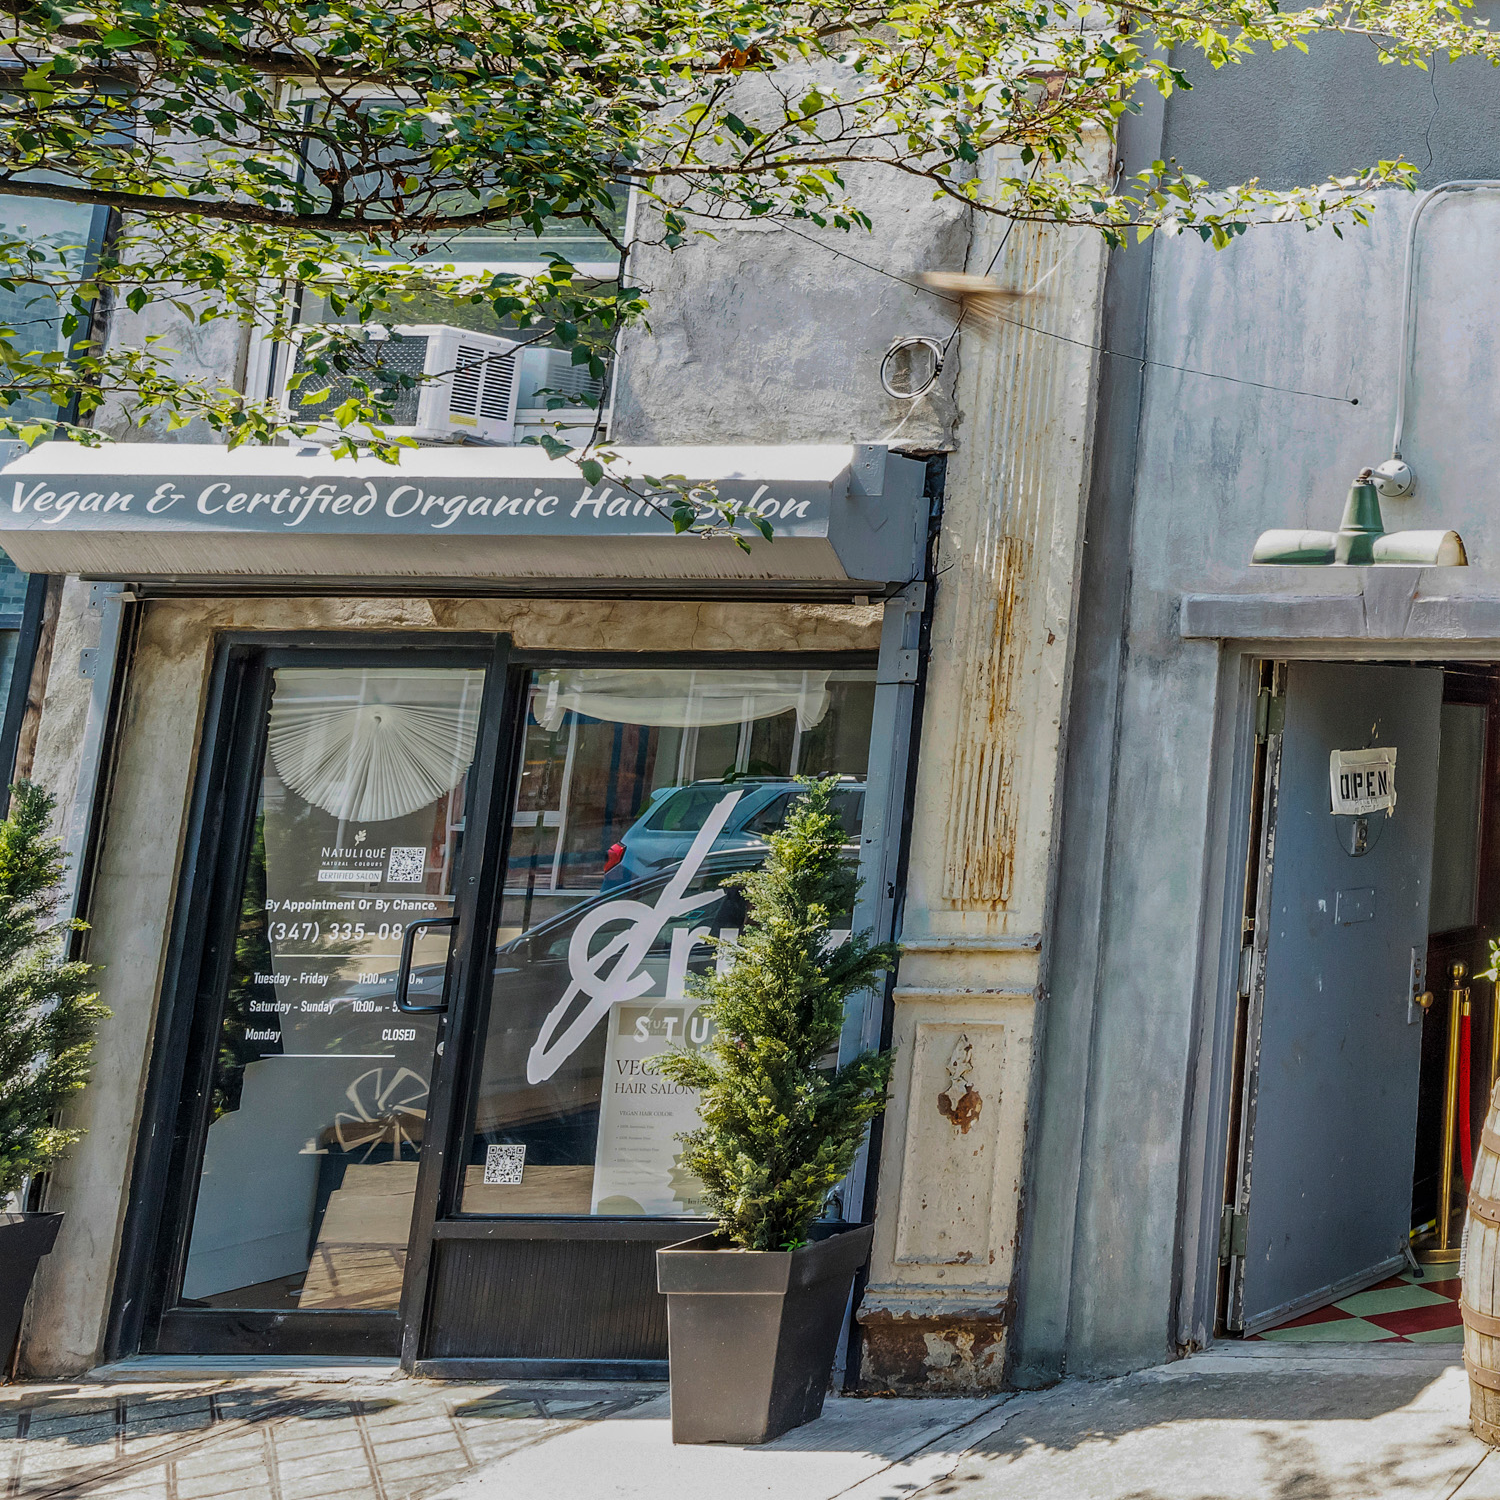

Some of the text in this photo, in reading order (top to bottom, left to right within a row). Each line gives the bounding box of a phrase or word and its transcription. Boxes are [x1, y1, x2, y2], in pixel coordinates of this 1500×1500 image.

[12, 481, 135, 525] Vegan
[145, 482, 186, 514] &
[196, 481, 378, 527] Certified
[385, 484, 558, 529] Organic
[570, 484, 669, 519] Hair
[1340, 770, 1388, 800] OPEN
[321, 847, 387, 859] NATULIQUE
[320, 871, 380, 880] CERTIFIED SALON
[265, 899, 438, 913] By Appointment Or By Chance.
[267, 921, 429, 943] (347) 335-089
[254, 972, 291, 986] Tuesday
[300, 972, 329, 986] Friday
[249, 1000, 292, 1014] Saturday
[300, 1000, 335, 1014] Sunday
[245, 1028, 416, 1042] Monday CLOSED
[614, 1083, 695, 1095] HAIR SALON
